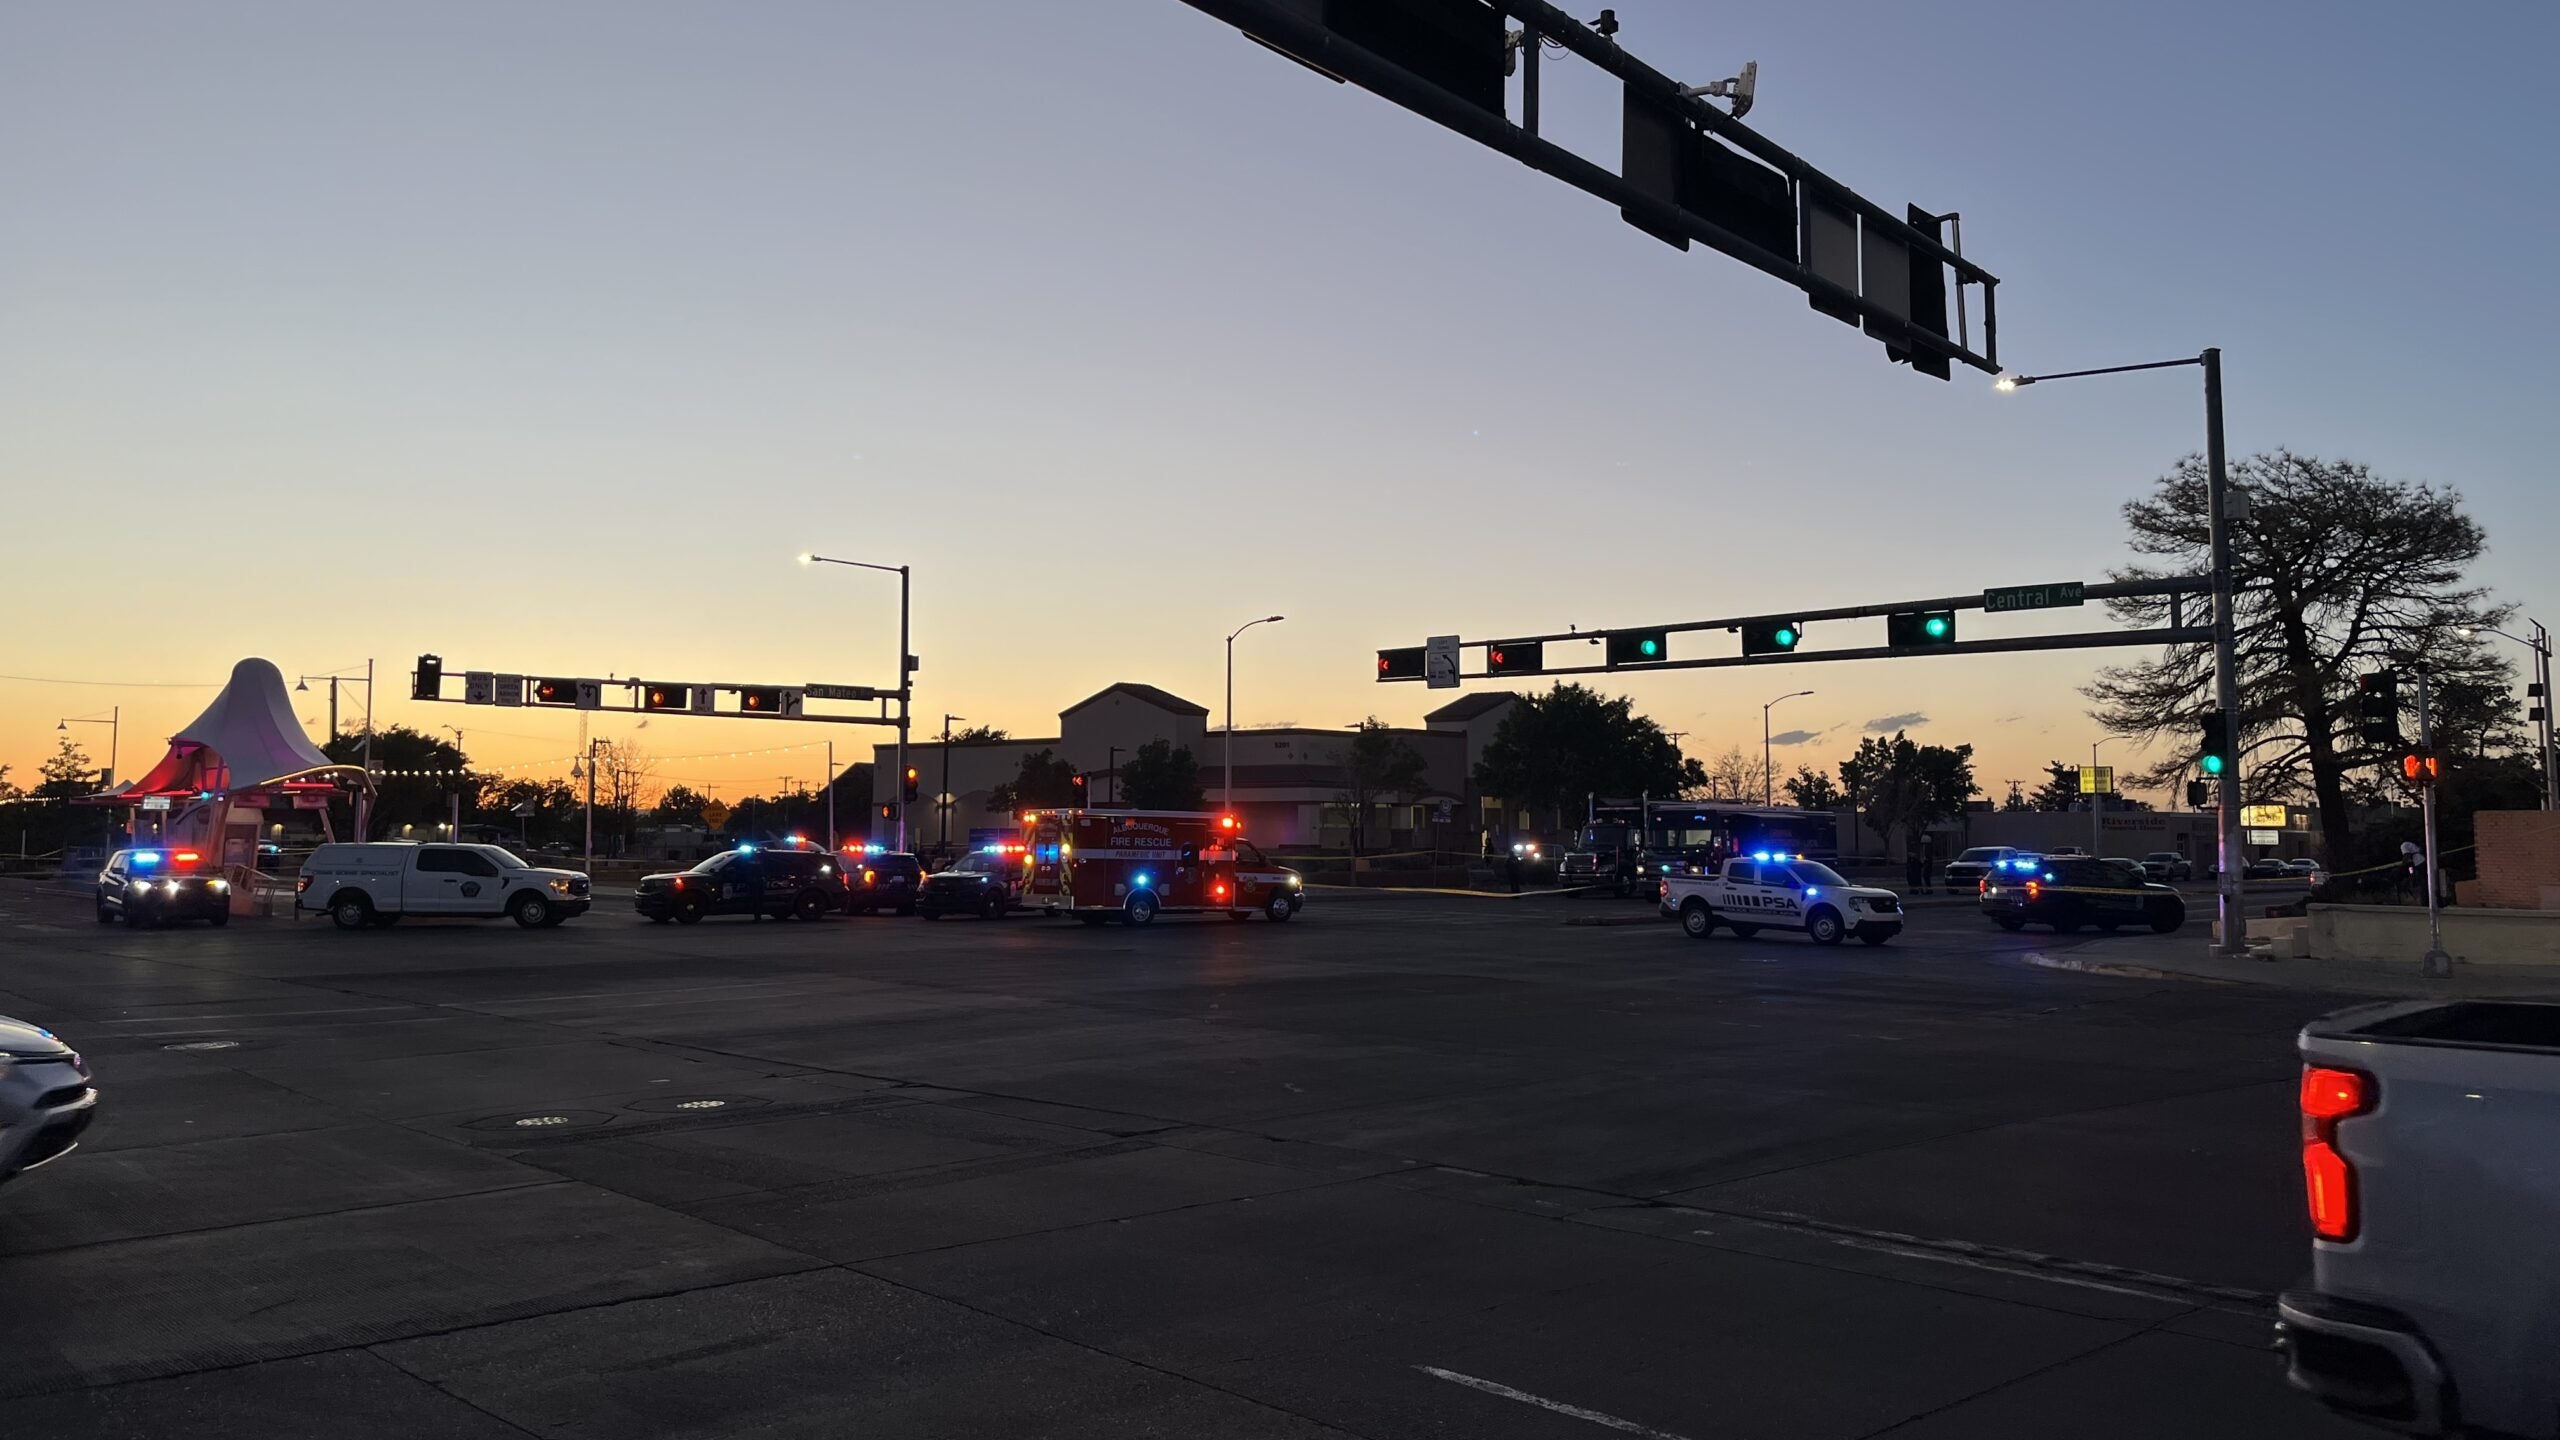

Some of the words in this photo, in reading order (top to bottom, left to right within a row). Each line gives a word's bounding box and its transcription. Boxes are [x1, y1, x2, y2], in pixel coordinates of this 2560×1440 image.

[1985, 588, 2050, 609] Central
[2060, 586, 2082, 599] Ave
[806, 684, 824, 697] San
[828, 686, 857, 698] Mateo
[2102, 817, 2166, 825] Riverside
[1113, 822, 1170, 836] ALBUQUERQUE
[1110, 836, 1131, 847] FIRE
[1134, 836, 1172, 847] RESCUE
[1762, 896, 1798, 909] PSA
